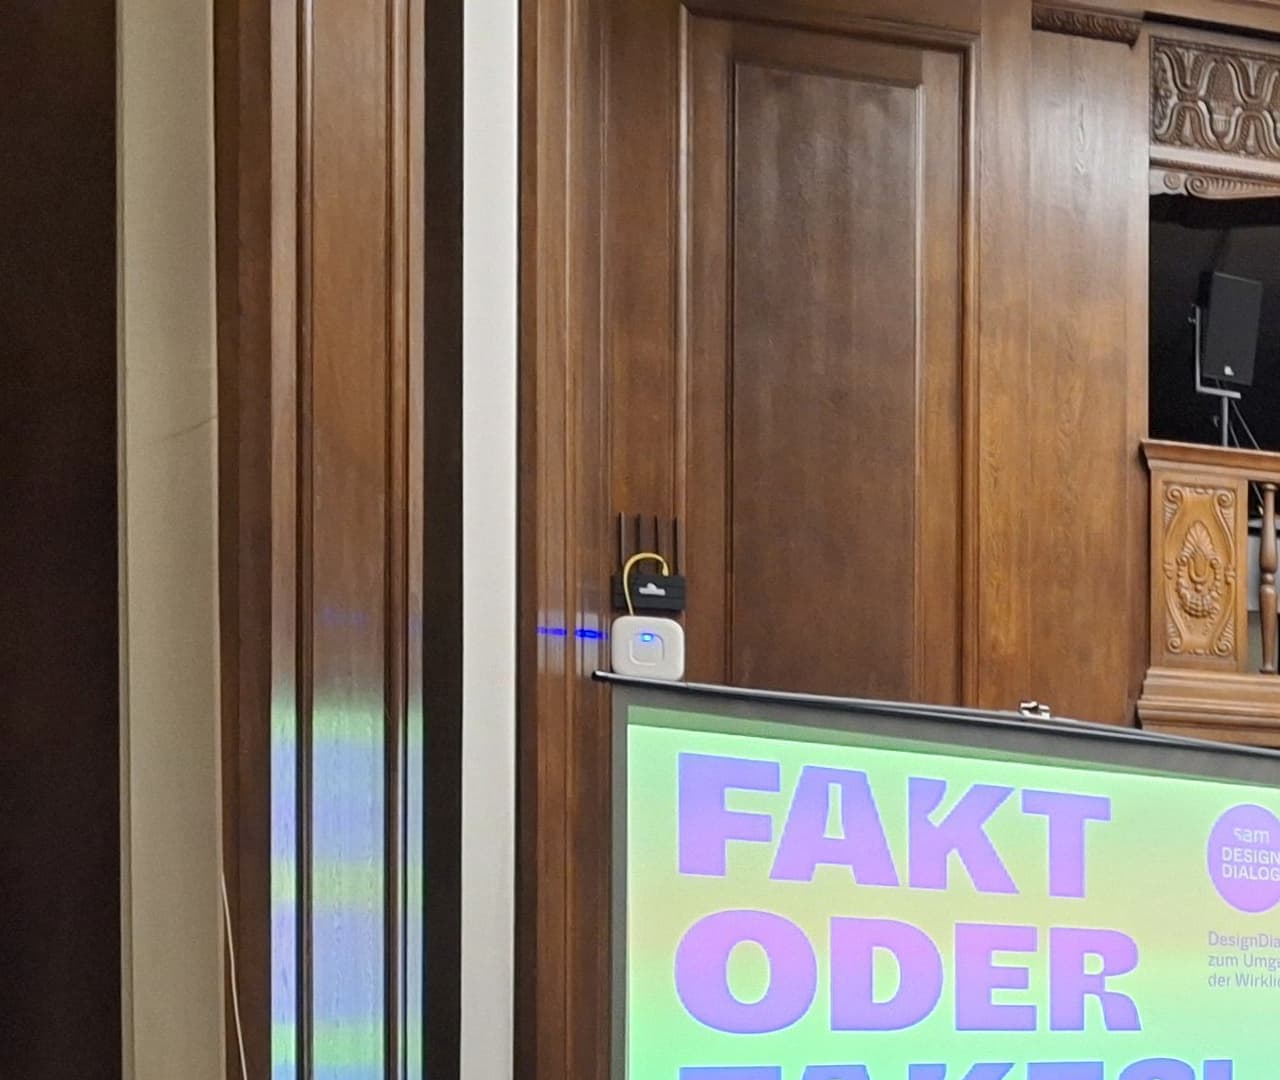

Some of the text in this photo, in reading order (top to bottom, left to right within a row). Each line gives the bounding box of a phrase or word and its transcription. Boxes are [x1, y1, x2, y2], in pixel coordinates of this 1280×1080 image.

[676, 752, 1112, 899] FAKT
[1233, 828, 1270, 843] sam
[1208, 954, 1239, 967] zum
[674, 909, 1143, 1035] ODER
[1208, 973, 1231, 988] der
